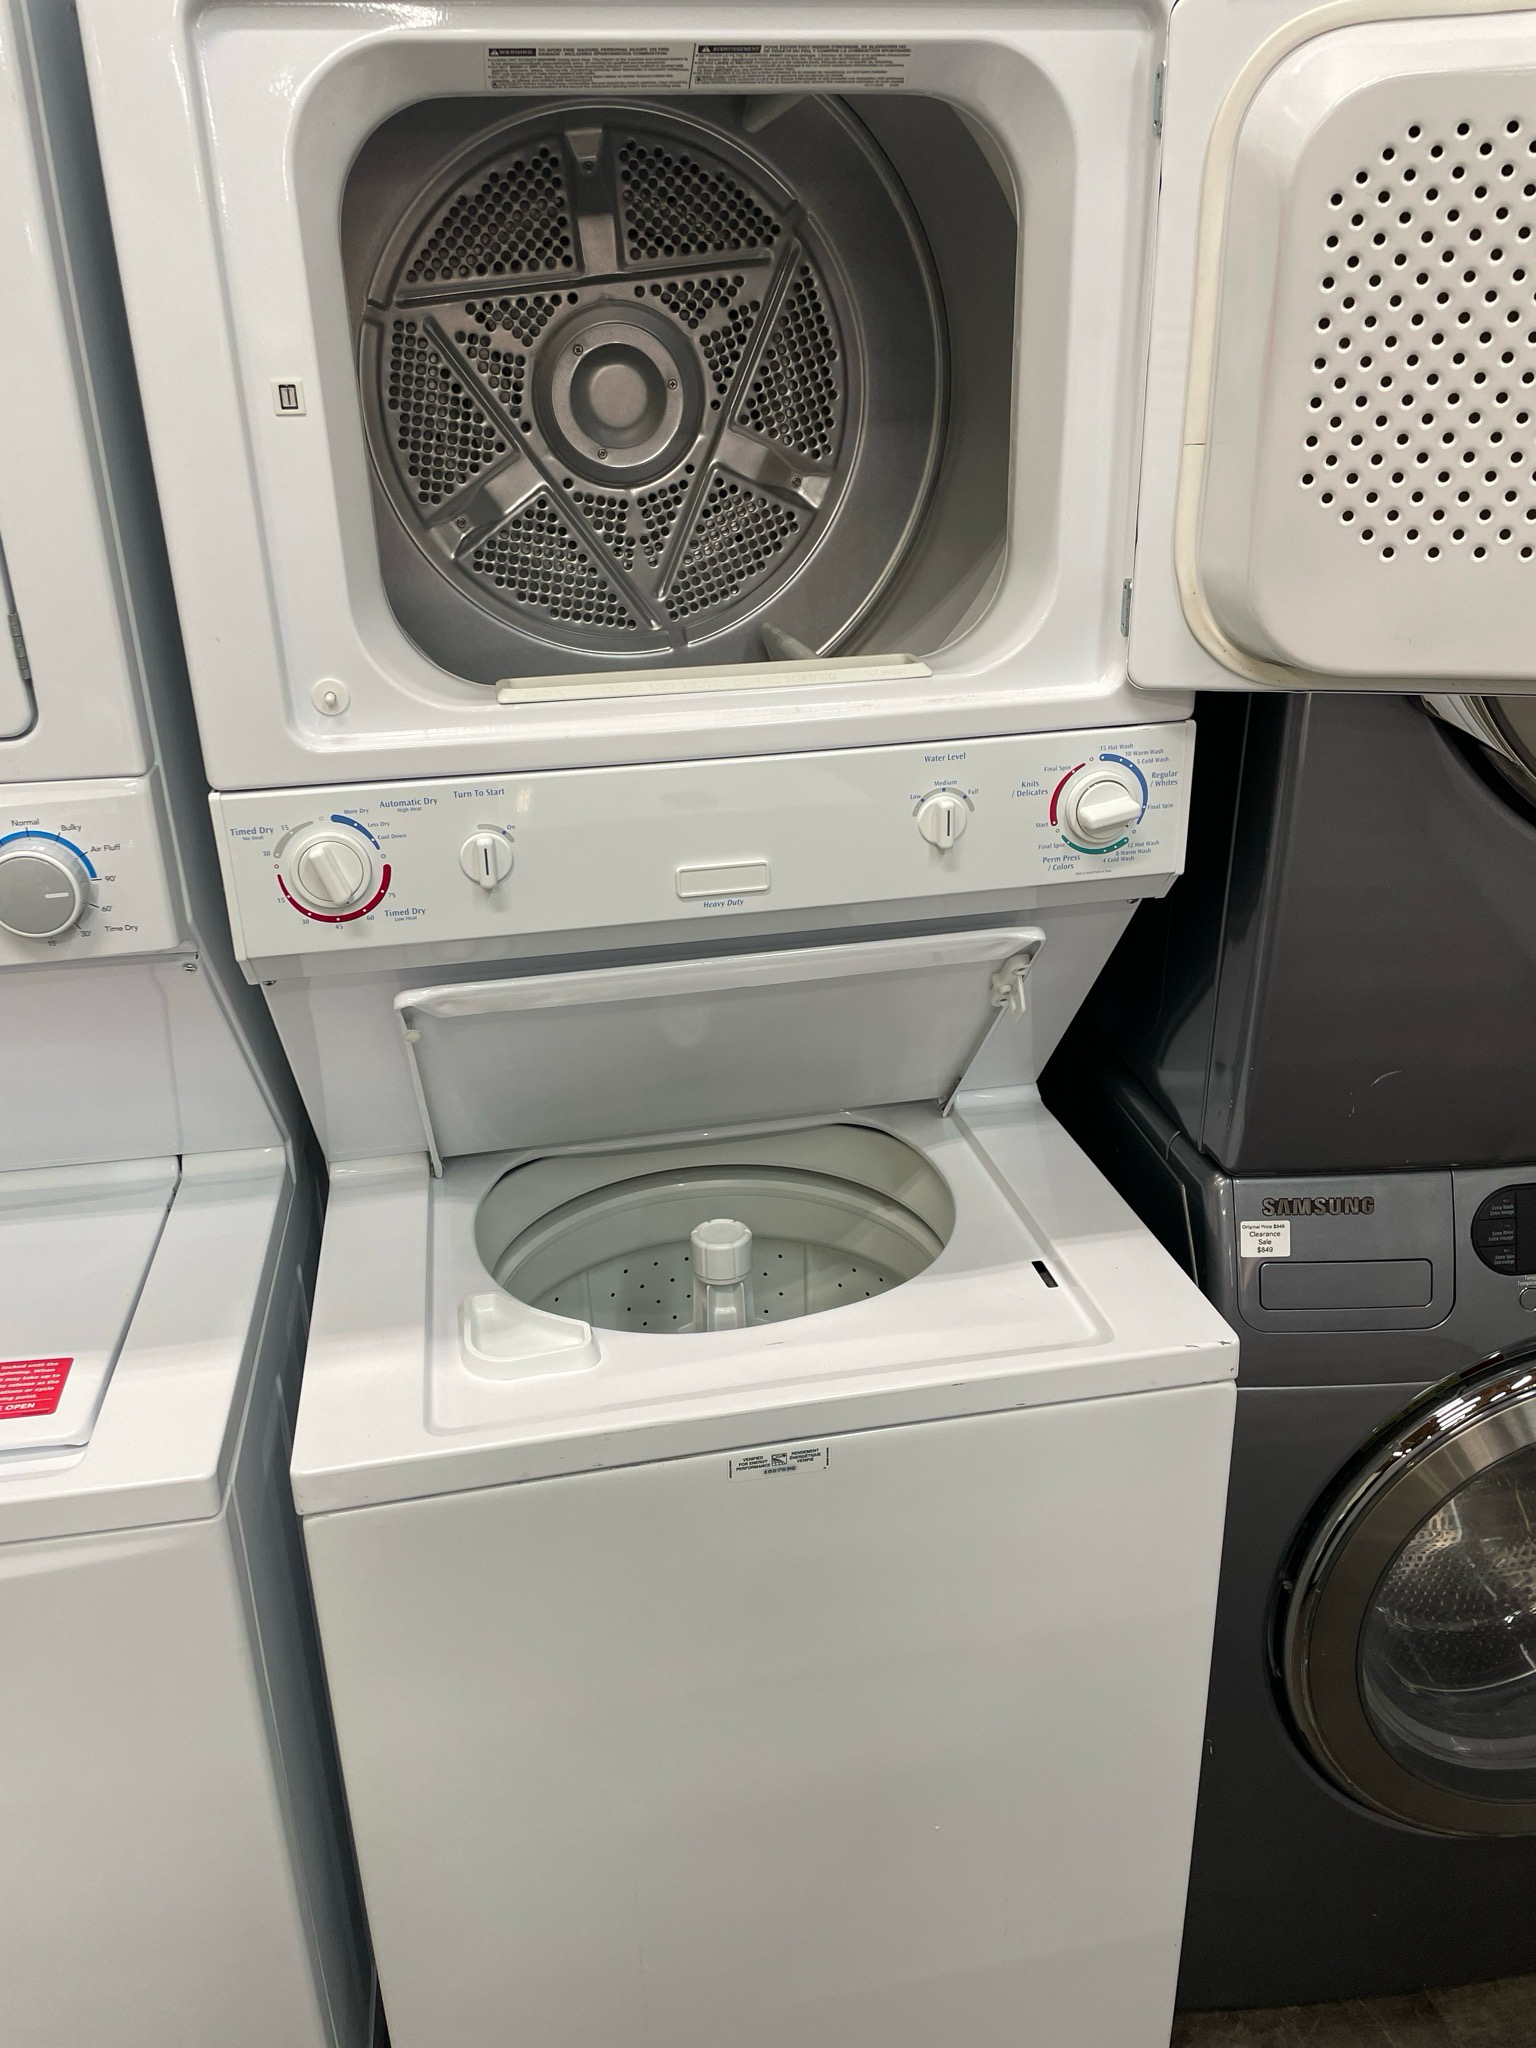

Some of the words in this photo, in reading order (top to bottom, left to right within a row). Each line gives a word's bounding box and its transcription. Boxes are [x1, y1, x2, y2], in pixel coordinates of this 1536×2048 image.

[924, 755, 946, 763] Water
[947, 752, 966, 761] Level
[1151, 770, 1178, 779] Regular
[1021, 780, 1039, 788] Knits
[1155, 779, 1178, 787] Whites
[453, 790, 472, 798] Turn
[474, 789, 484, 797] To
[486, 788, 505, 796] Start
[1016, 789, 1048, 798] Delicates
[380, 798, 421, 808] Automatic
[423, 797, 438, 806] Dry
[11, 818, 40, 827] Normal
[61, 824, 82, 832] Bulky
[230, 827, 256, 836] Timed
[259, 826, 274, 835] Dry
[1052, 863, 1074, 871] Colors
[703, 901, 725, 909] Heavy
[727, 899, 745, 907] Duty
[384, 908, 410, 917] Timed
[412, 907, 426, 916] Dry
[125, 924, 139, 932] Dry
[1262, 1196, 1375, 1217] SAMSUNG
[1257, 1246, 1274, 1254] $849
[5, 1402, 36, 1410] OPEN
[791, 1448, 819, 1456] RENDEMENT
[736, 1463, 770, 1471] PERFORMANCE
